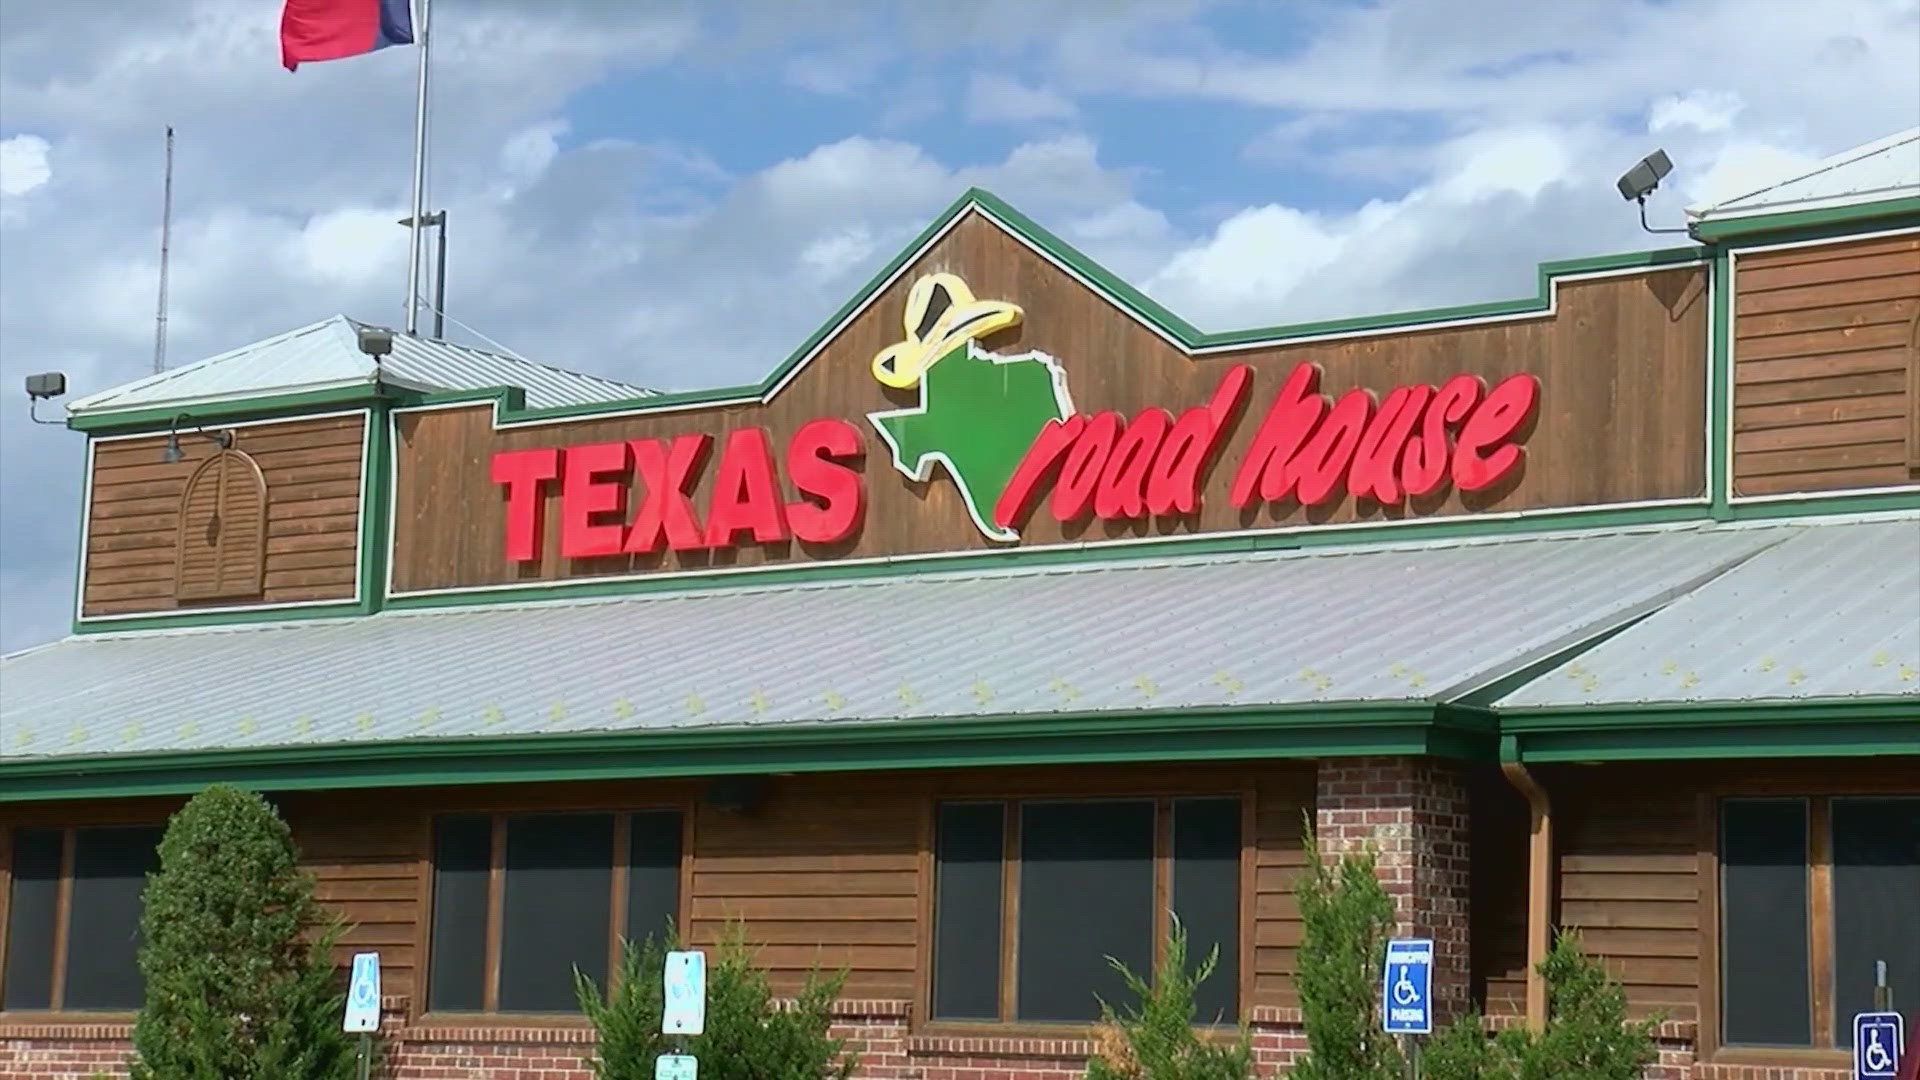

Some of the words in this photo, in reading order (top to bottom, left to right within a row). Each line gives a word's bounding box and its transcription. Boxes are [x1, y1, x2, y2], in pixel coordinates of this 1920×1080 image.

[490, 418, 866, 562] TEXAS
[994, 364, 1253, 529] road
[1231, 361, 1541, 509] house
